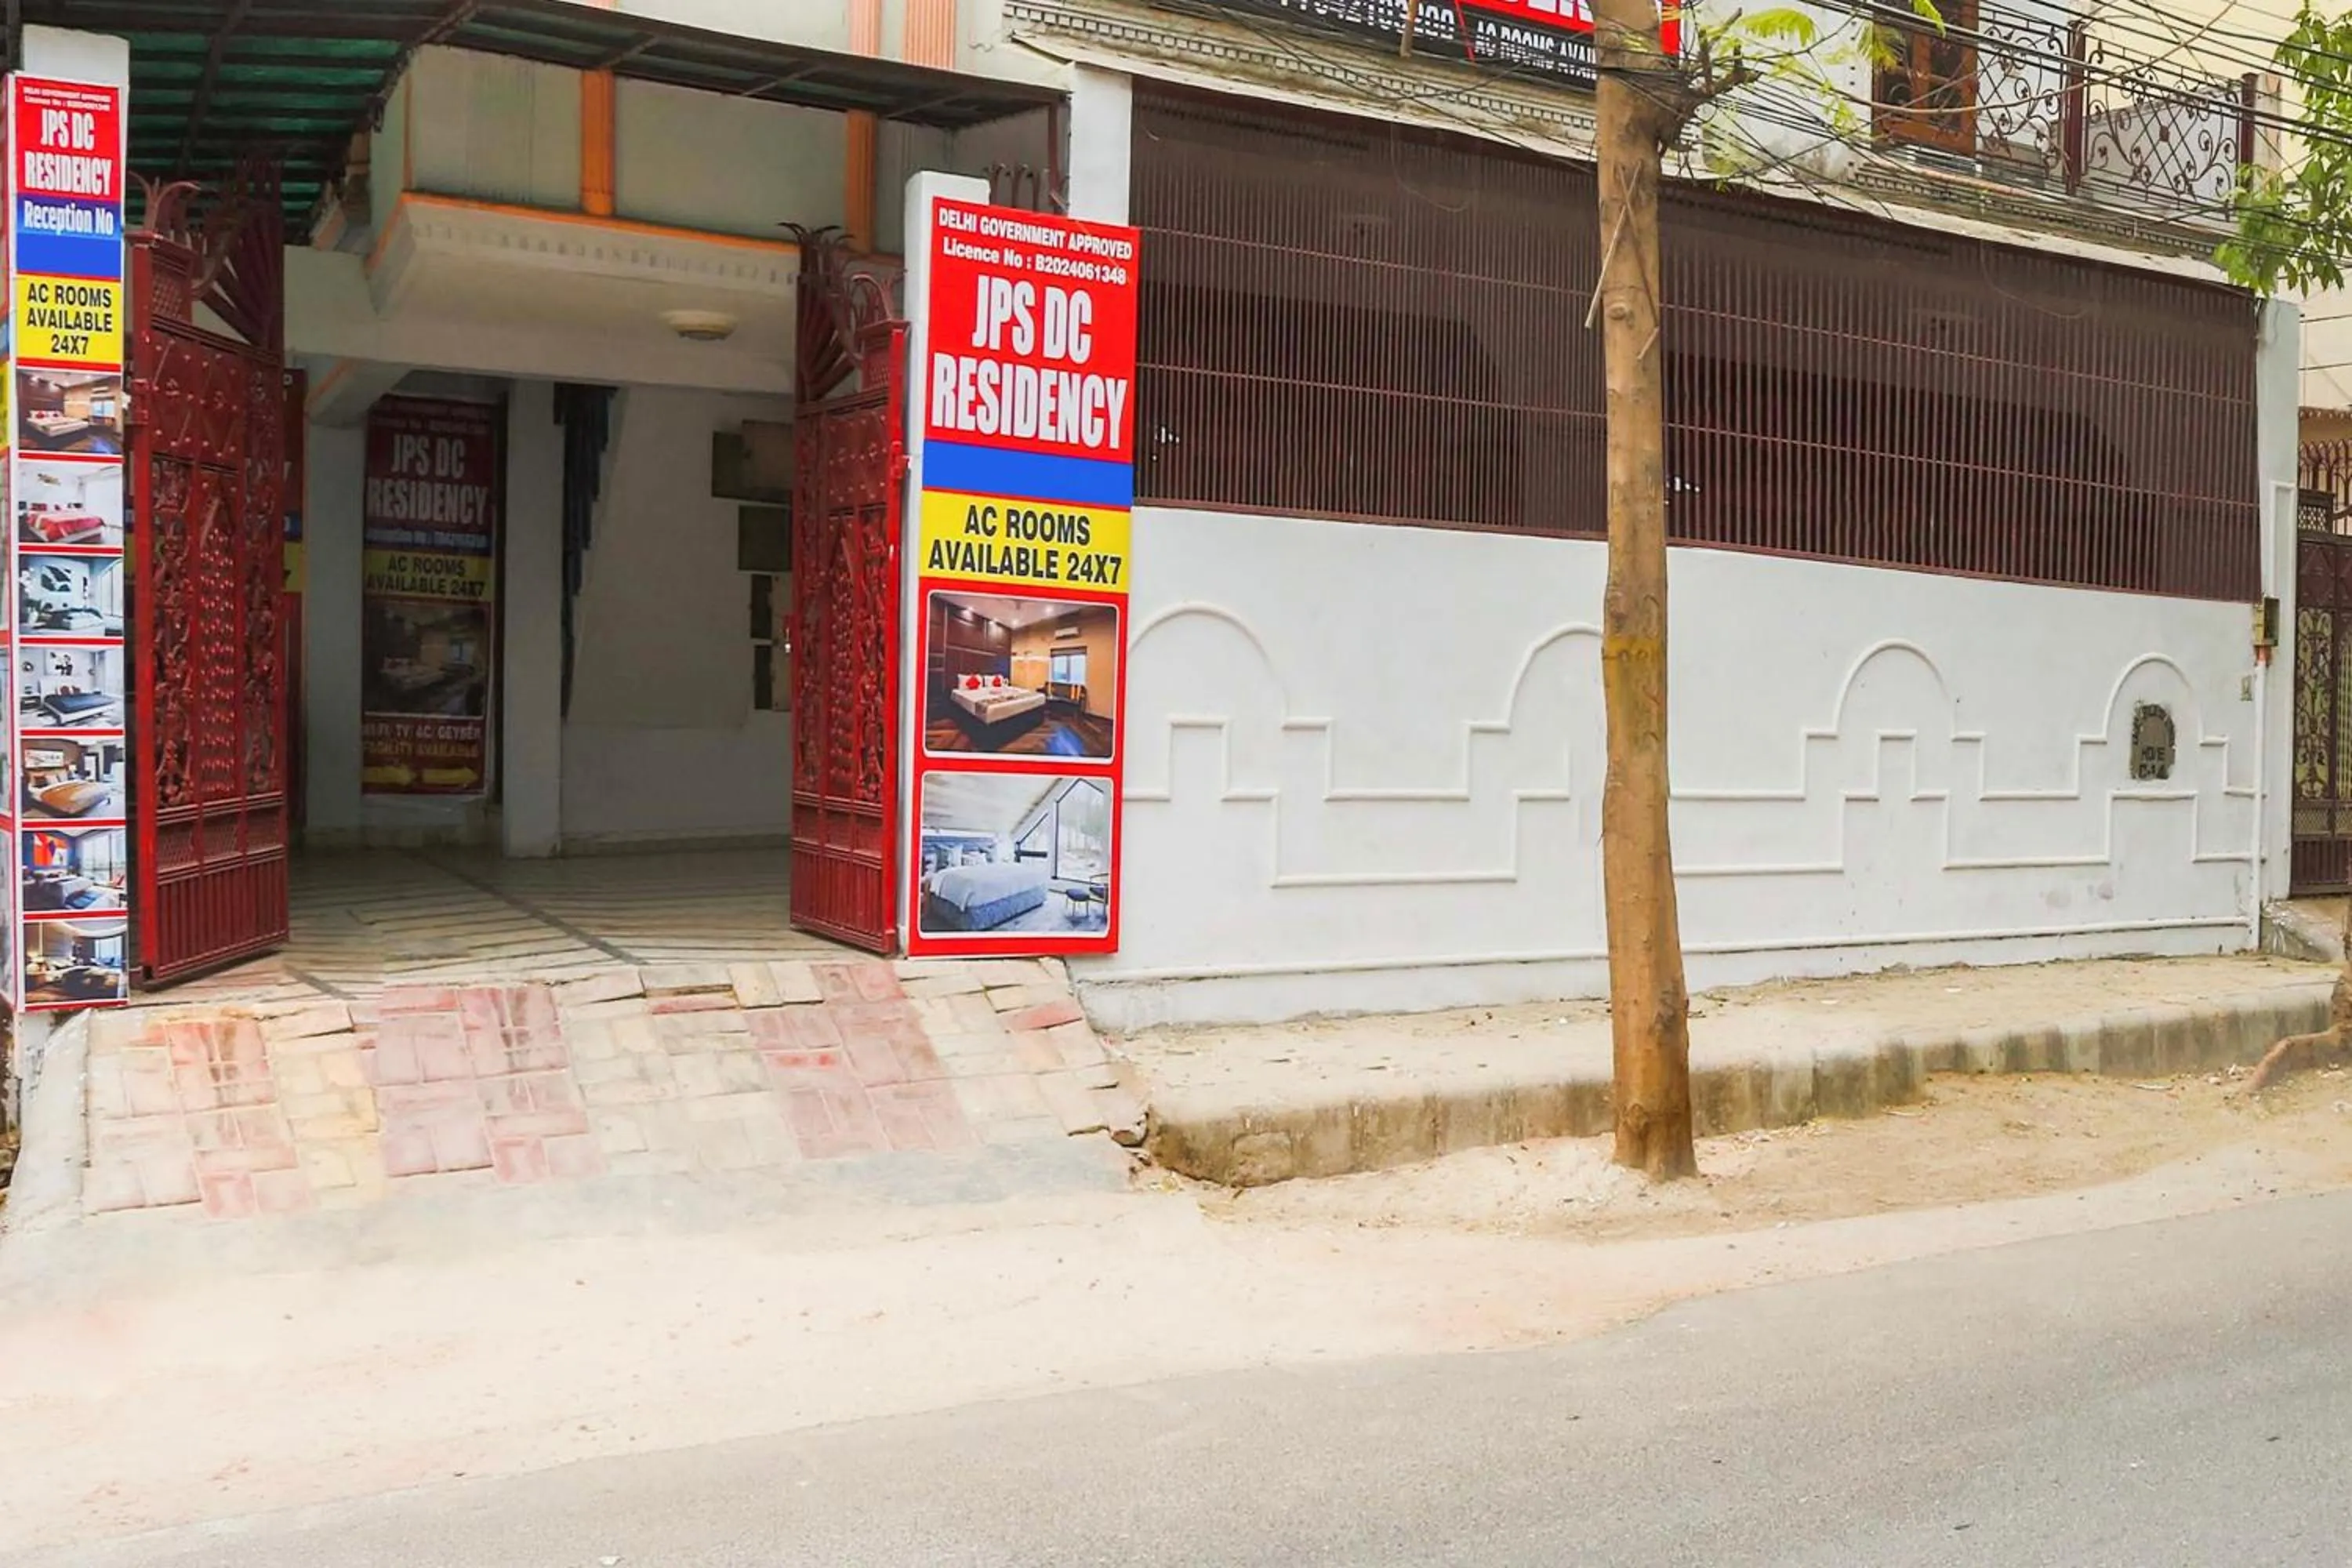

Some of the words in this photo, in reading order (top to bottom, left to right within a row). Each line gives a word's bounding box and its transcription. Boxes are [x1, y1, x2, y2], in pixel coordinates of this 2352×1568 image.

[41, 108, 67, 148] JPS
[73, 111, 94, 151] DC
[24, 151, 112, 195] RESIDENCY
[24, 200, 93, 235] Reception
[95, 207, 114, 234] No
[939, 207, 977, 232] DELHI
[980, 216, 1066, 249] GOVERNMENT
[1068, 230, 1133, 260] APPROVED
[943, 237, 1000, 265] Licence
[1003, 245, 1023, 269] No
[1035, 253, 1127, 285] B2024061348
[27, 283, 48, 303] AC
[54, 285, 111, 308] ROOMS
[27, 307, 113, 332] AVAILABLE
[972, 274, 1036, 358] JPS
[1043, 287, 1092, 365] DC
[51, 335, 89, 355] 24X7
[931, 352, 1127, 450] RESIDENCY
[391, 434, 430, 477] JPS
[435, 438, 466, 478] DC
[368, 478, 488, 525] RESIDENCY
[964, 504, 998, 538] AC
[1006, 510, 1091, 546] ROOMS
[388, 556, 408, 573] AC
[413, 557, 466, 578] ROOMS
[928, 539, 1059, 580] AVAILABLE
[1067, 552, 1122, 586] 24X7
